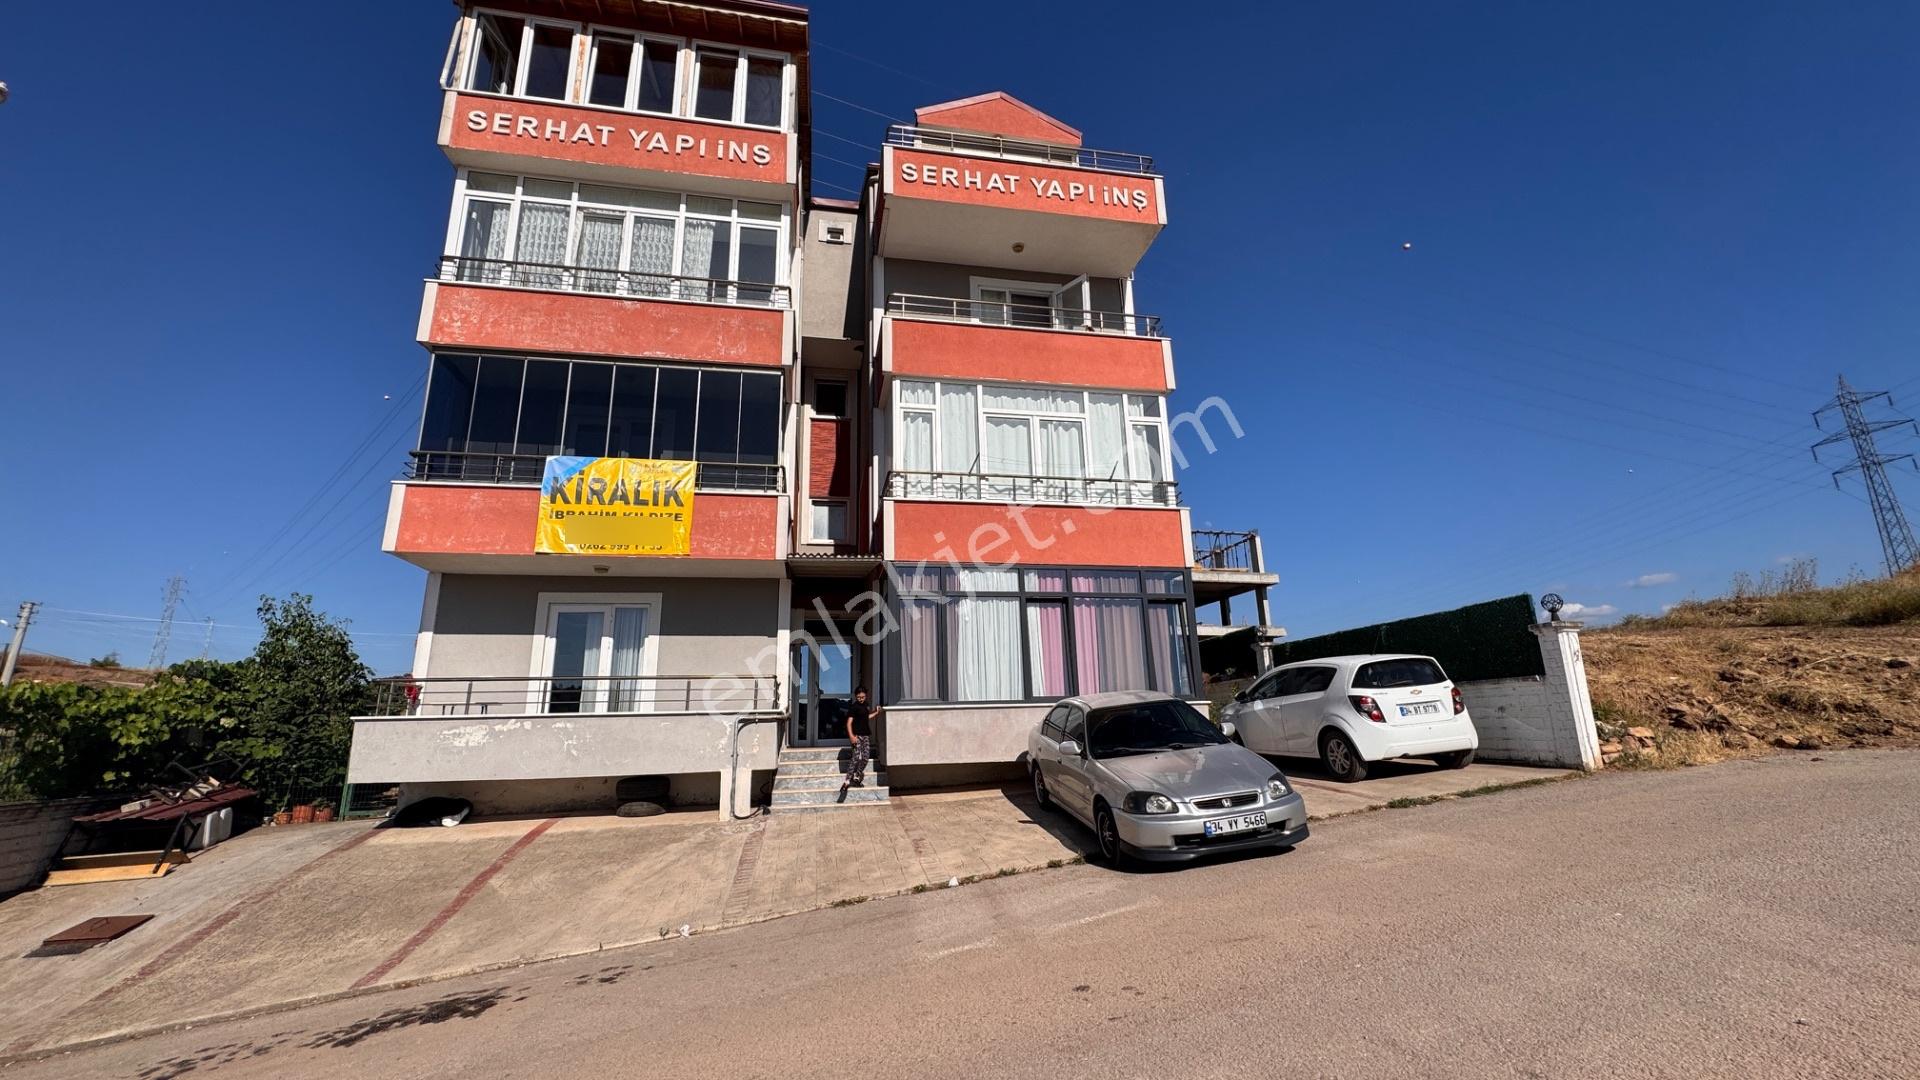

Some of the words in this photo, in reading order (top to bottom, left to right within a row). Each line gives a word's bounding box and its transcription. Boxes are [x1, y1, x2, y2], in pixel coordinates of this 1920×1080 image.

[467, 110, 616, 146] SERHAT
[628, 128, 706, 157] YAPI
[901, 162, 1020, 194] SERHAT
[1030, 178, 1094, 203] YAPI
[1211, 822, 1223, 833] 34
[1243, 815, 1266, 828] 5466
